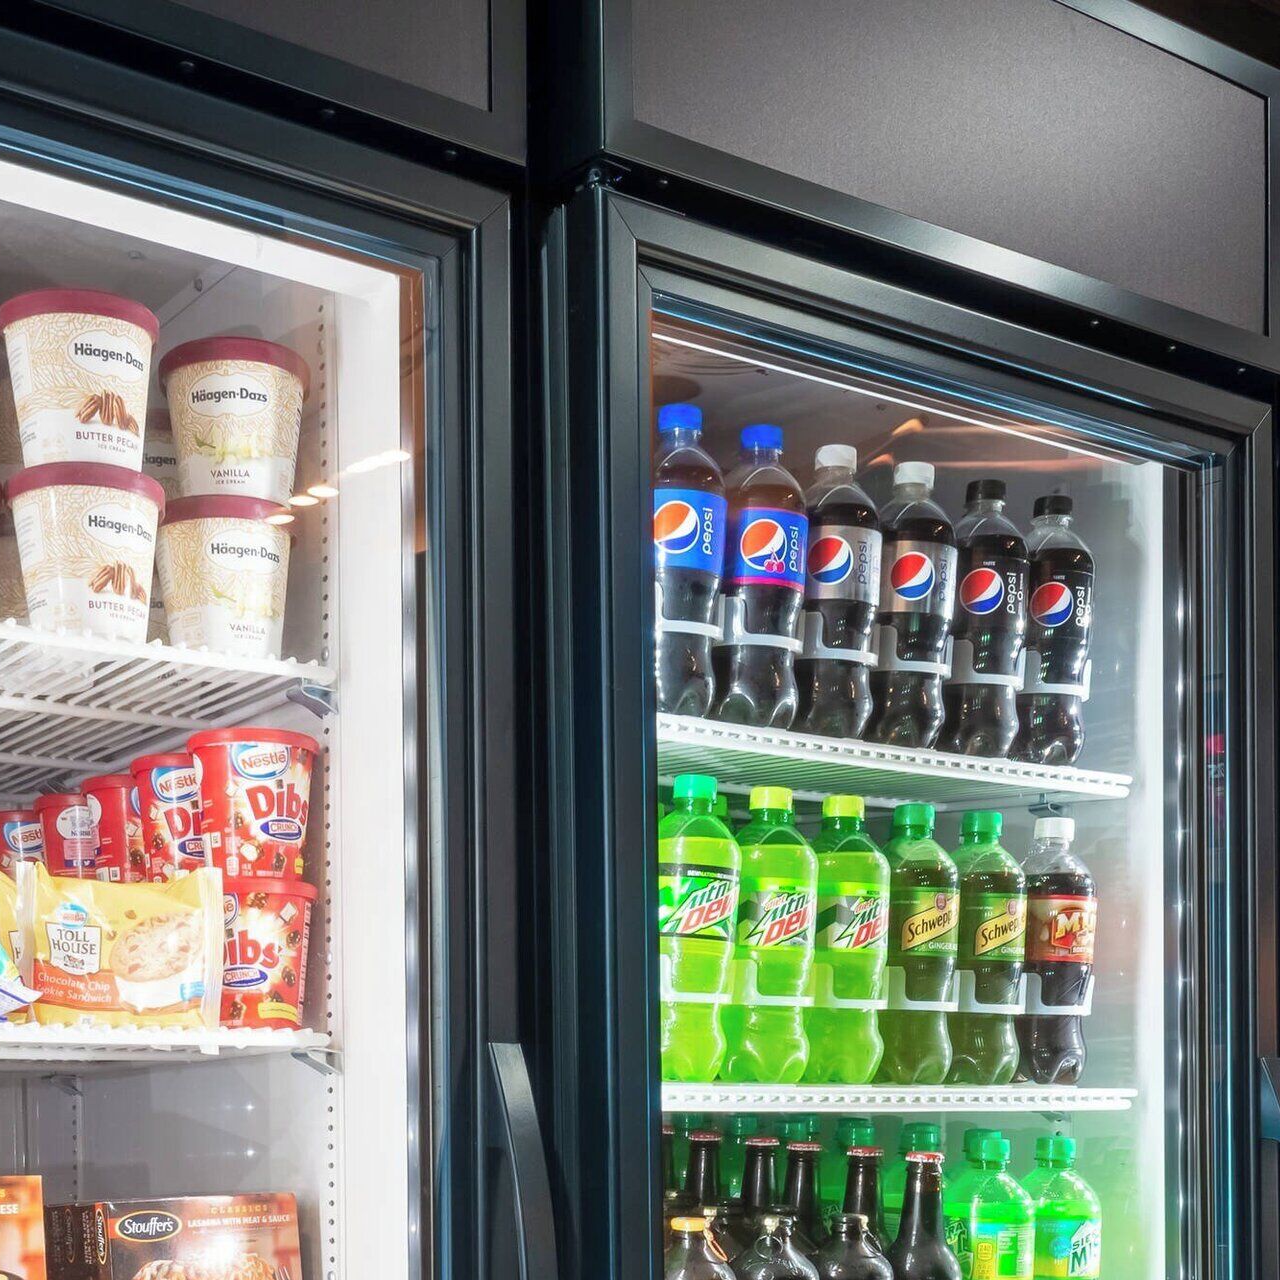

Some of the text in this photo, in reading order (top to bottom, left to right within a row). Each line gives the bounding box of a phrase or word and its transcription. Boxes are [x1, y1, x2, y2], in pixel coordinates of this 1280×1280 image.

[75, 430, 113, 443] BUTTER
[210, 468, 251, 479] VANILLA
[702, 507, 713, 556] pepsi
[789, 526, 799, 573] pepsi
[857, 540, 868, 585] pepsi
[939, 559, 948, 601] pepsi
[1006, 572, 1017, 614] pepsi
[88, 600, 124, 612] BUTTER
[1075, 586, 1086, 628] pepsi
[229, 622, 267, 636] VANILLA
[245, 779, 308, 827] Dibs
[57, 929, 90, 942] TOLL
[52, 939, 97, 956] HOUSE
[223, 928, 281, 970] ibs
[37, 971, 111, 996] Chocolate Chip
[66, 987, 112, 1003] Sandwich
[210, 1204, 269, 1214] CLASSICS
[221, 1217, 242, 1226] WITH
[242, 1216, 261, 1225] MEAT
[269, 1214, 290, 1223] SAUCE
